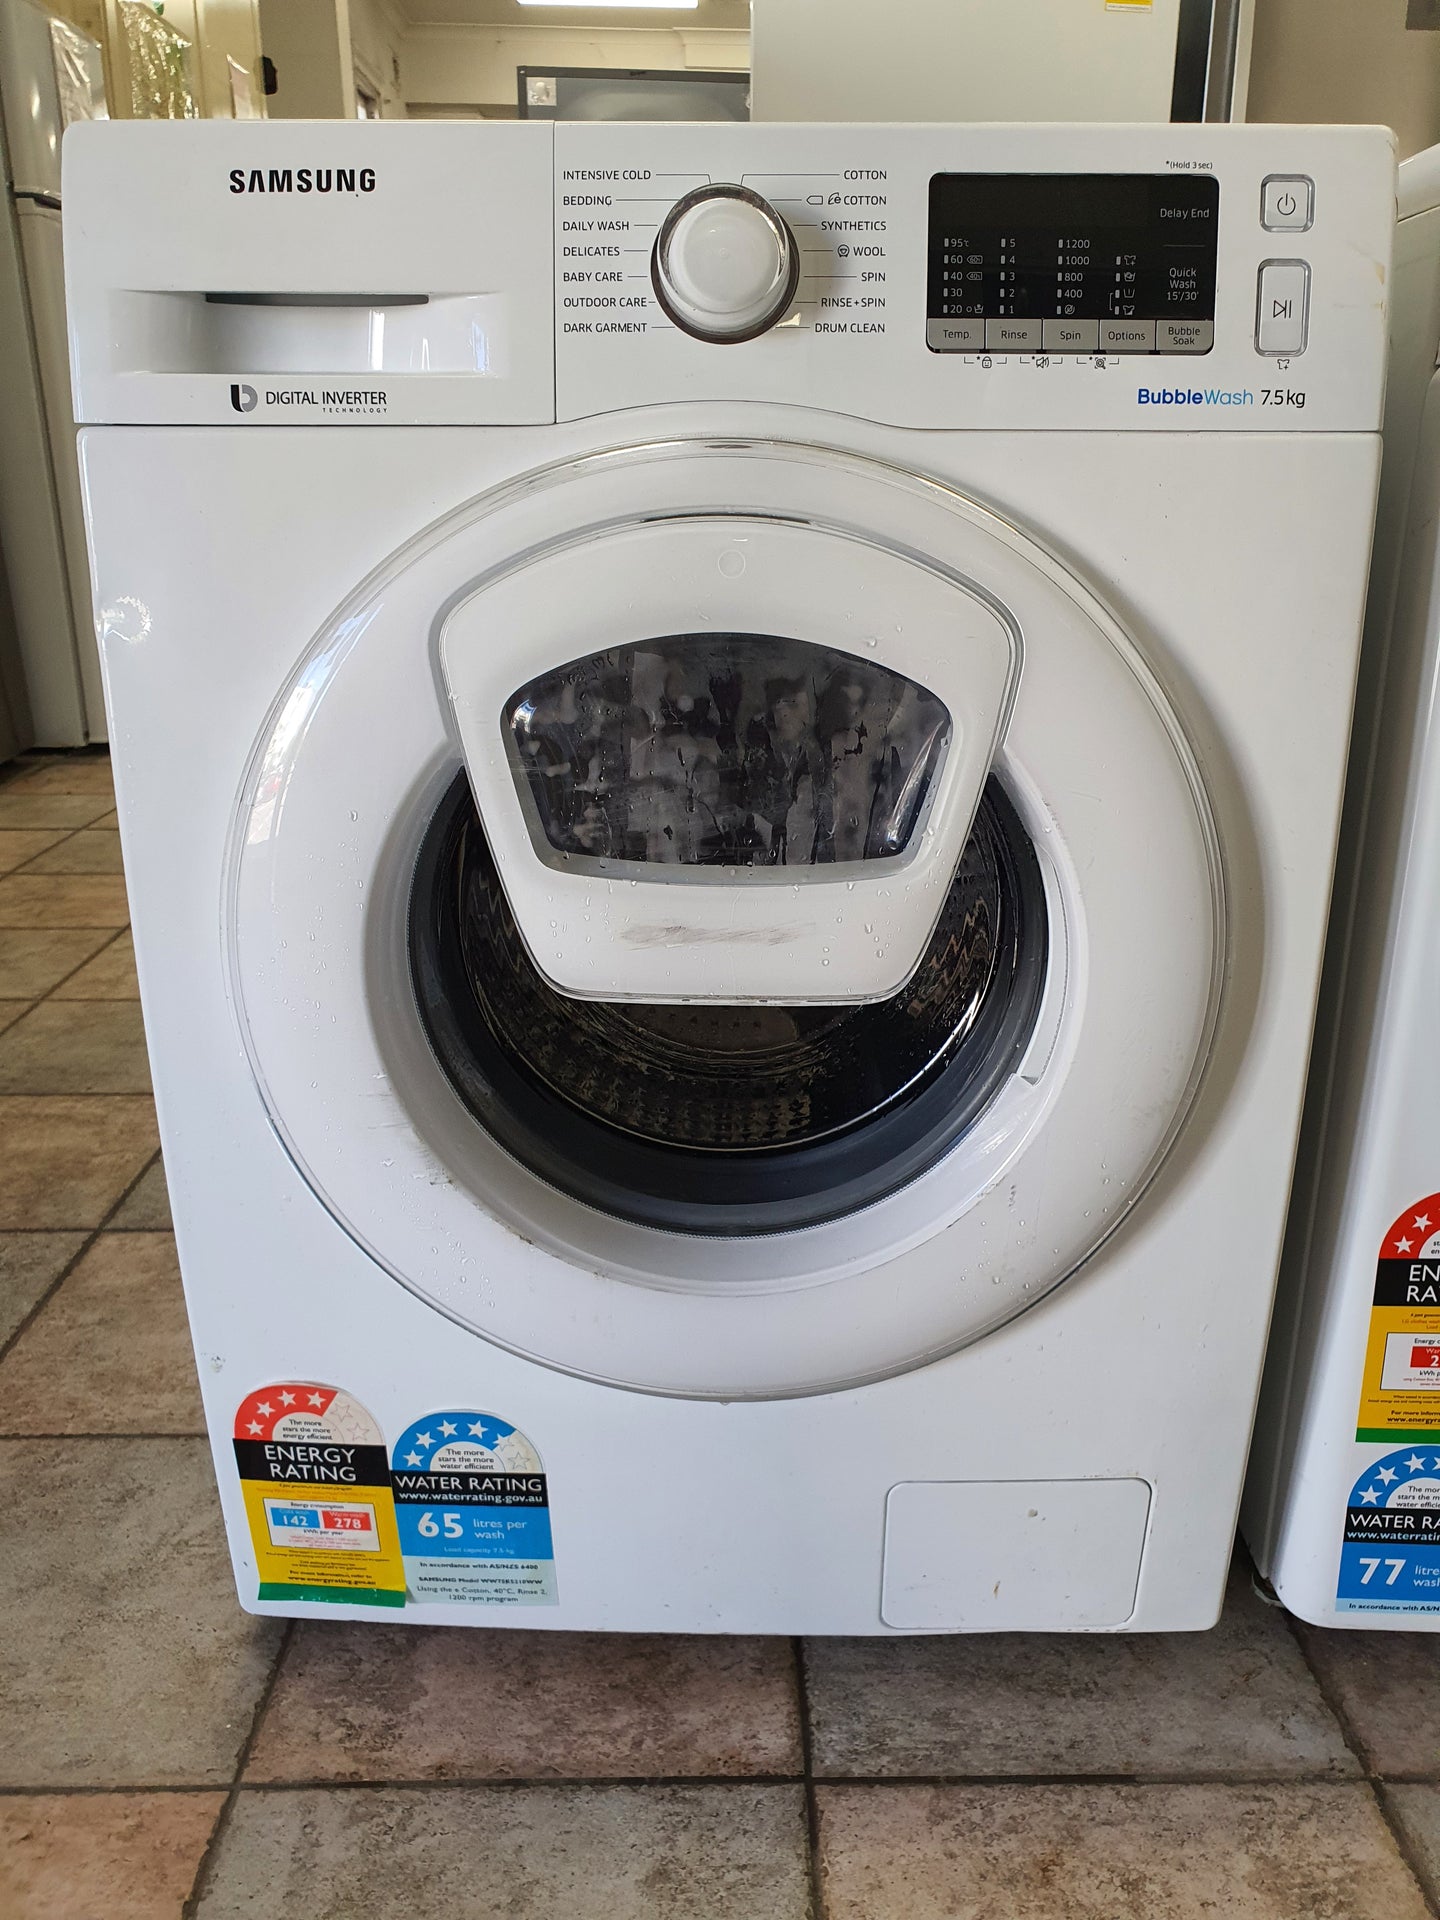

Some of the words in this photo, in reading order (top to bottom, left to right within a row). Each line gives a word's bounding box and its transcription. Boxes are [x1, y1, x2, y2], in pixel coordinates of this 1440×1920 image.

[1198, 161, 1213, 169] sec)
[563, 170, 620, 180] INTENSIVE
[622, 170, 651, 180] COLD
[843, 170, 887, 180] COTTON
[229, 169, 376, 194] SAMSUNG
[563, 196, 612, 206] BEDDING
[843, 195, 887, 206] COTTON
[1160, 208, 1189, 220] Delay
[1191, 208, 1210, 218] End
[562, 221, 594, 231] DAILY
[597, 221, 630, 231] WASH
[821, 221, 887, 231] SYNTHETICS
[1010, 239, 1016, 248] 5
[1066, 239, 1090, 249] 1200
[563, 246, 620, 257] DELICATES
[853, 246, 886, 257] WOOL
[950, 255, 963, 264] 60
[1009, 255, 1016, 264] 4
[1065, 256, 1090, 265] 1000
[563, 272, 592, 282] BABY
[595, 272, 623, 282] CARE
[861, 272, 886, 282] SPIN
[950, 272, 963, 281] 40
[1009, 272, 1016, 281] 3
[1064, 272, 1083, 282] 800
[1169, 267, 1197, 278] Quick
[1170, 279, 1196, 289] Wash
[950, 288, 963, 297] 30
[1009, 288, 1015, 298] 2
[1064, 289, 1083, 298] 400
[563, 297, 617, 308] OUTDOOR
[619, 297, 647, 308] CARE
[950, 304, 963, 314] 20
[1009, 305, 1014, 314] 1
[563, 323, 593, 333] DARK
[595, 323, 648, 333] GARMENT
[815, 323, 847, 333] DRUM
[850, 323, 885, 333] CLEAN
[1168, 326, 1200, 336] Bubble
[943, 329, 972, 341] Temp.
[1001, 330, 1028, 340] Rinse
[1060, 330, 1081, 342] Spin
[1108, 331, 1146, 342] Options
[1173, 336, 1195, 346] Soak
[266, 391, 318, 405] DIGITAL
[322, 391, 387, 405] INVERTER
[264, 1445, 356, 1464] ENERGY
[446, 1448, 461, 1456] The
[270, 1463, 357, 1482] RATING
[395, 1475, 463, 1490] WATER
[469, 1477, 542, 1491] RATING
[399, 1492, 543, 1504] www.waterrating.gov.au
[283, 1515, 309, 1526] 142
[334, 1518, 362, 1529] 278
[417, 1512, 464, 1539] 65
[473, 1518, 503, 1529] litres
[506, 1521, 528, 1531] per
[1350, 1514, 1415, 1529] WATER
[474, 1530, 505, 1539] wash
[1360, 1558, 1407, 1586] 77
